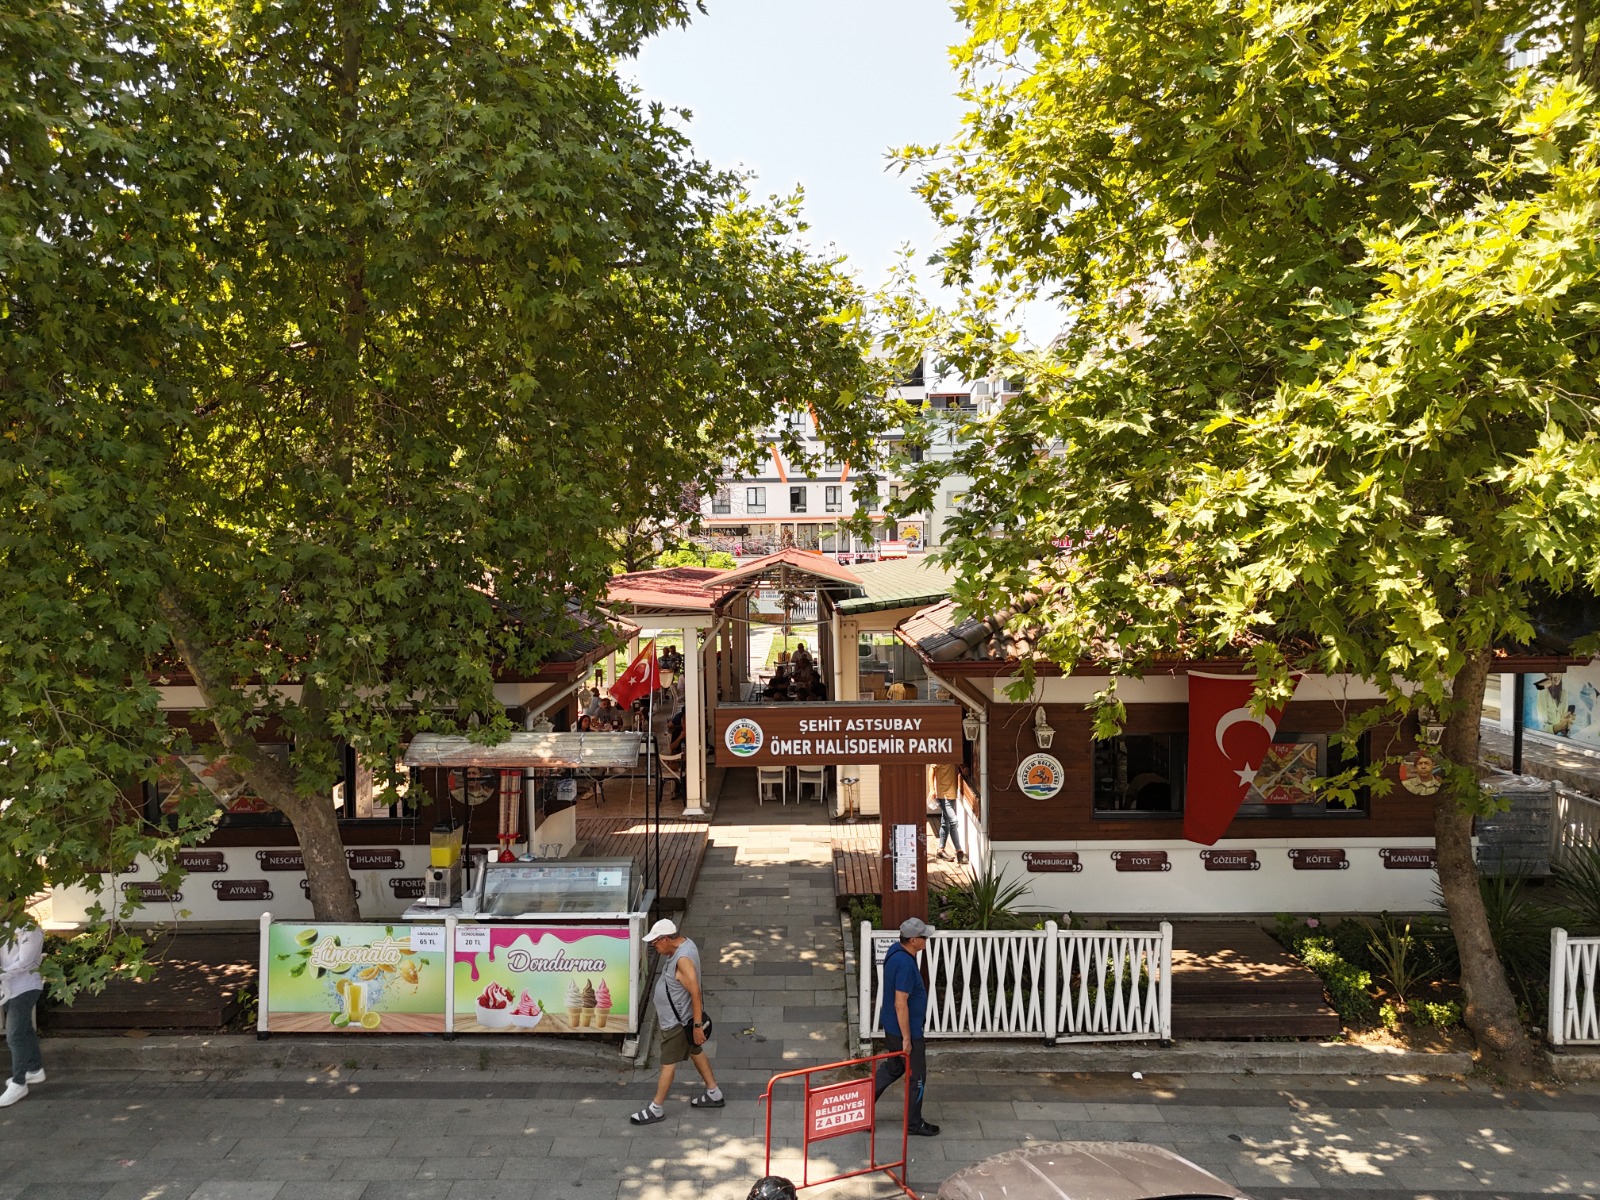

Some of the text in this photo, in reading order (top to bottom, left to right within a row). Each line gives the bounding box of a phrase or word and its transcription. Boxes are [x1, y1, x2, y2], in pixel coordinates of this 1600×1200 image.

[799, 716, 922, 734] ŞEHİT ASTSUBAY
[770, 734, 953, 755] ÖMER HALİSDEMİR PARKI
[184, 858, 210, 866] KAHVE
[1131, 857, 1151, 865] TOST
[1213, 856, 1247, 864] GÖZLEME
[1306, 855, 1331, 863] KÖFTE
[1390, 855, 1429, 863] KAHVALTI
[229, 886, 257, 894] AYRAN
[310, 936, 403, 969] Limonata
[508, 949, 606, 972] Dondurma
[822, 1091, 859, 1105] ATAKUM
[815, 1099, 866, 1117] BELEDİYESİ
[816, 1111, 863, 1128] ZABITA
